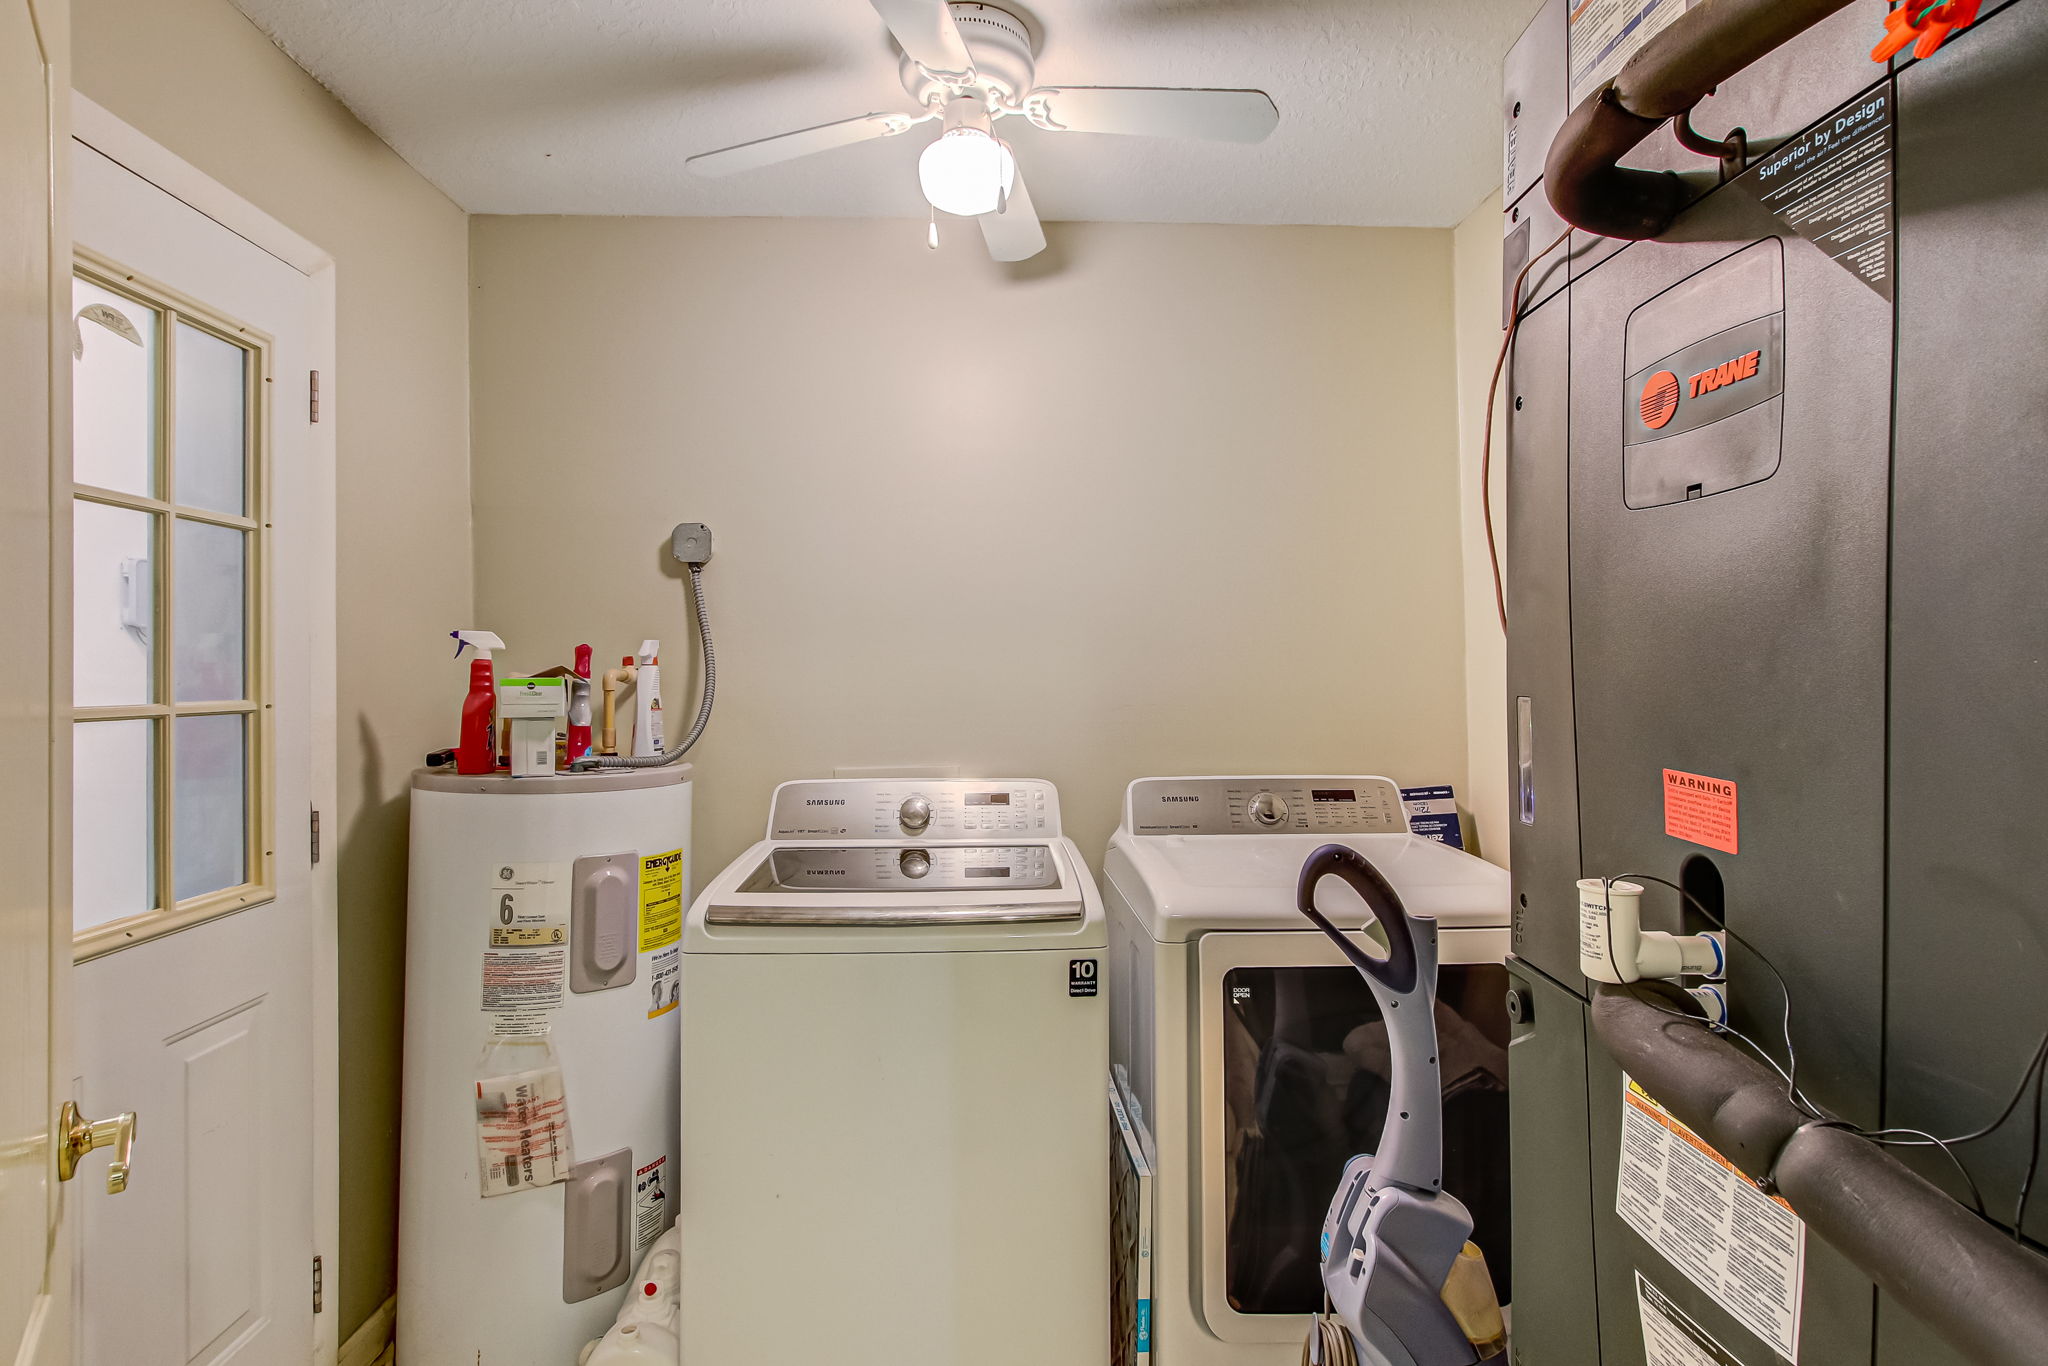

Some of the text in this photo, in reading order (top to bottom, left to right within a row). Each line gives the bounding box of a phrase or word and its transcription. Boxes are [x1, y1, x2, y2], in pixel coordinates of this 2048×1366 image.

[1759, 96, 1885, 180] Superior by Design
[1688, 350, 1762, 399] TRANE
[1668, 774, 1732, 796] WARNING
[500, 893, 514, 926] 6
[1071, 961, 1095, 979] 10
[1636, 1101, 1662, 1122] WARNING
[515, 1085, 534, 1182] Water Heaters
